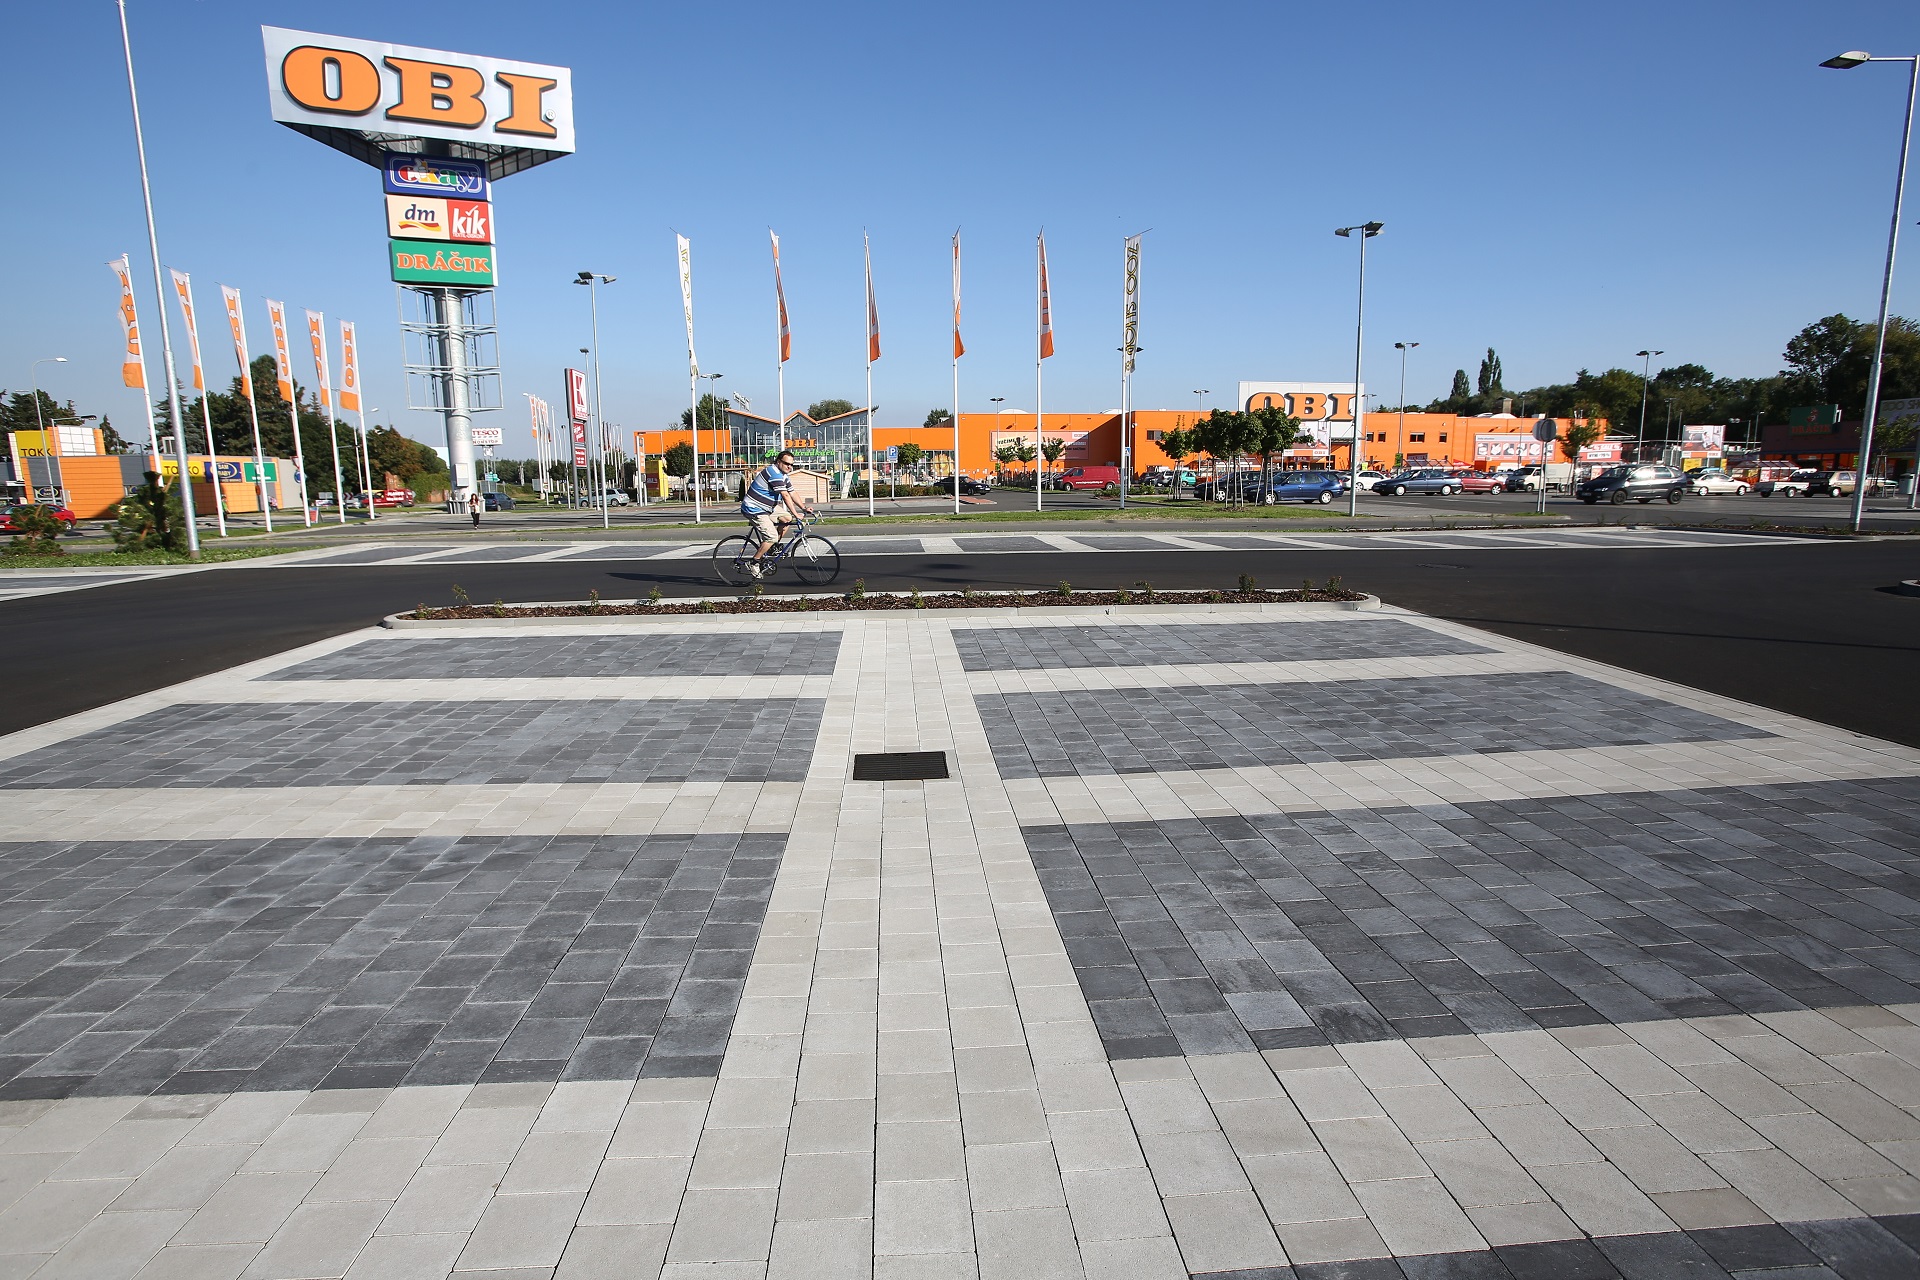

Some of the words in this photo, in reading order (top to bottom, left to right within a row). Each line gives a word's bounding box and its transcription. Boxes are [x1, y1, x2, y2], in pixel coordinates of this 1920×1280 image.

[282, 45, 557, 138] OBI
[404, 204, 435, 221] dm
[396, 251, 491, 273] DRÁČIK
[1126, 243, 1140, 295] ZOO
[343, 327, 355, 388] OBI
[1245, 392, 1357, 421] OBI
[784, 439, 817, 448] OBI
